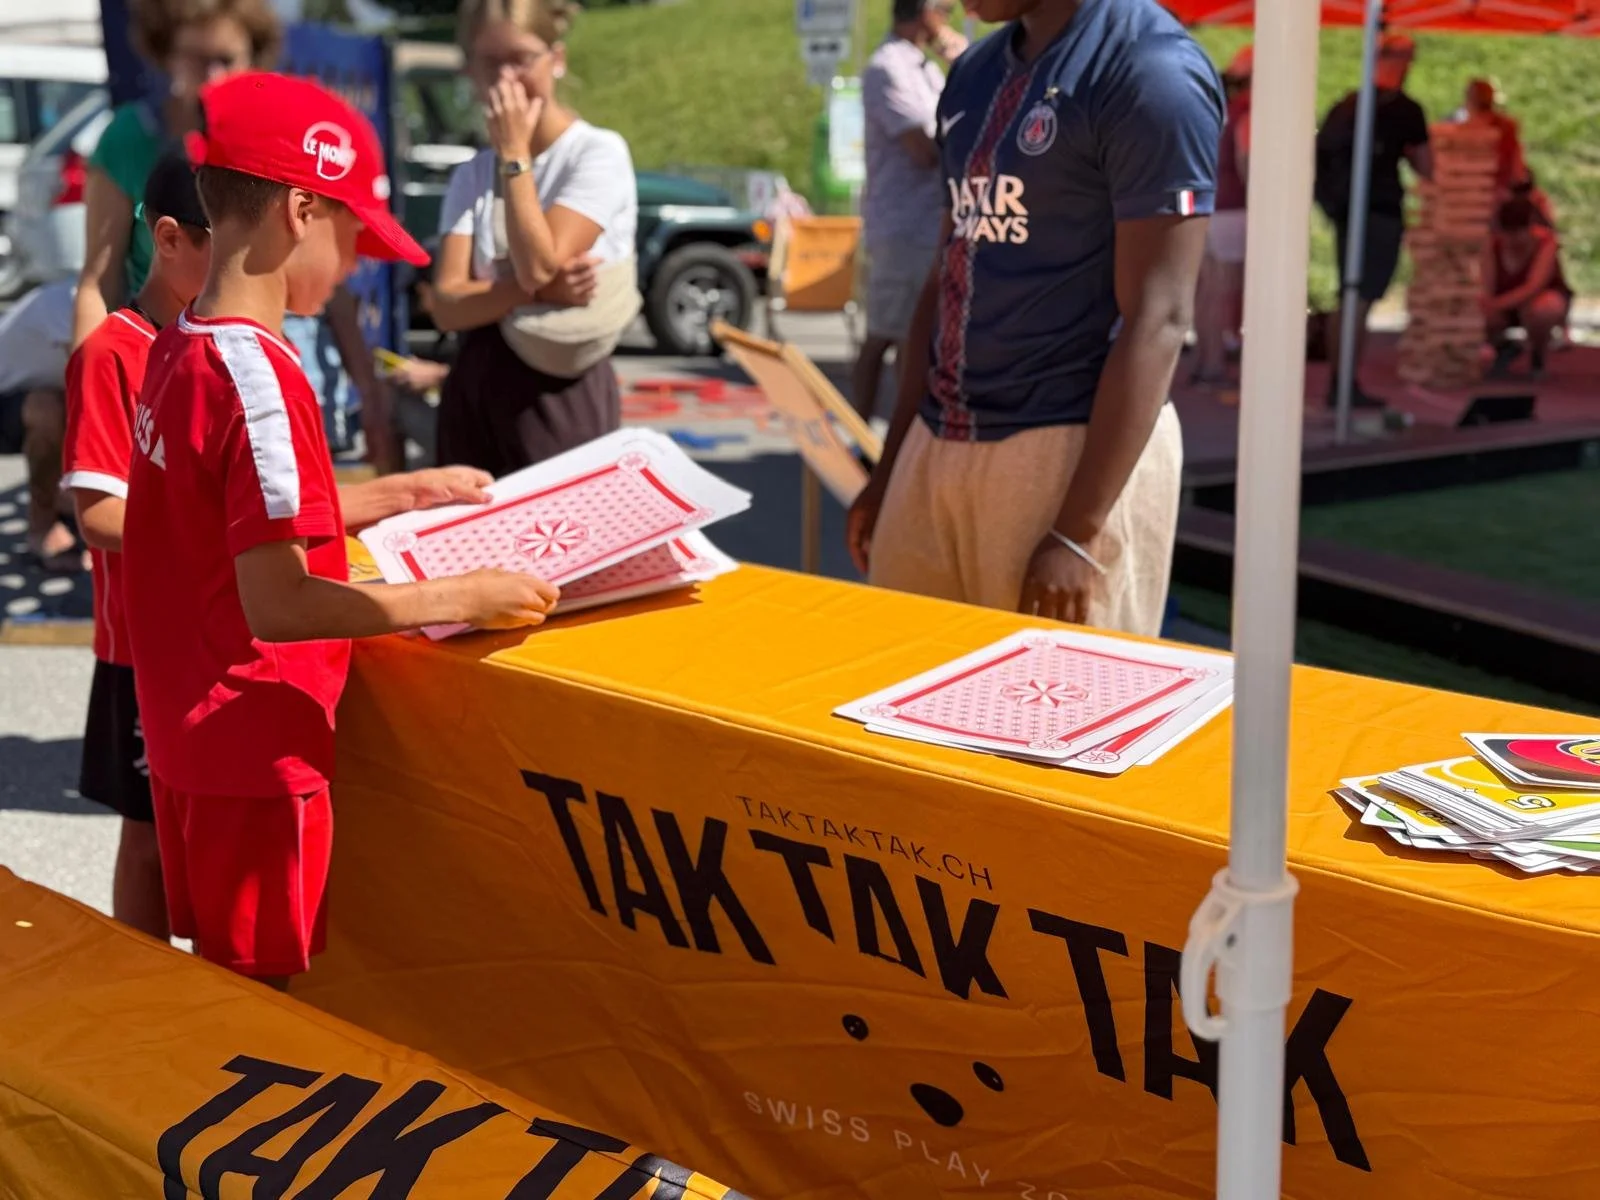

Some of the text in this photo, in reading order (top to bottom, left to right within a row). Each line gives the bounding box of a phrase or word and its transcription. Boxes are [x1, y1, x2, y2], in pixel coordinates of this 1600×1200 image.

[735, 795, 993, 890] TAKTAKTAK.CH
[520, 768, 1372, 1172] TAK TAK TAK
[157, 1054, 511, 1200] TAK
[743, 1090, 991, 1188] SWISS PLAY
